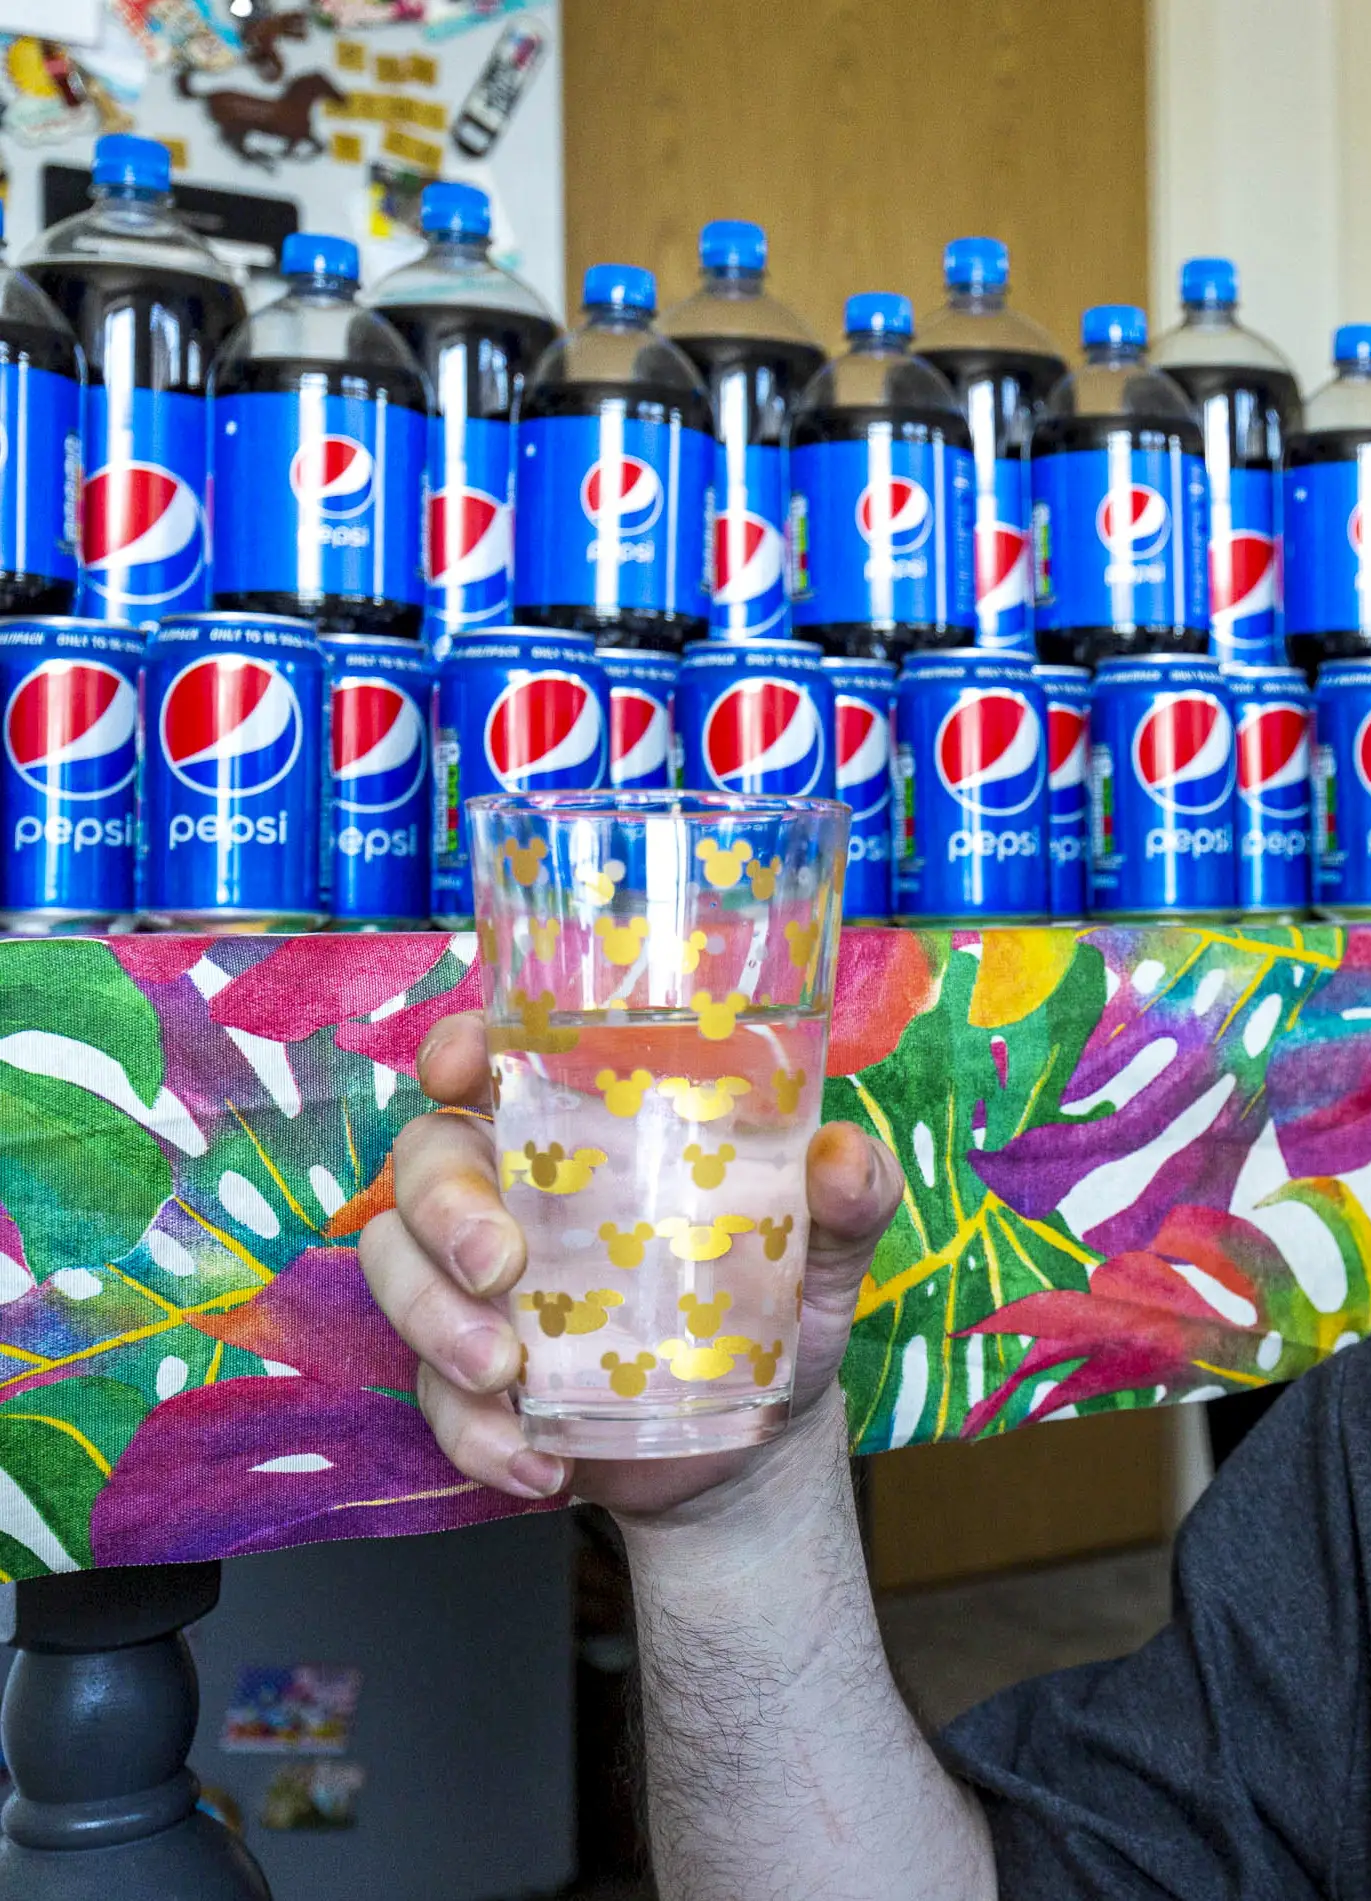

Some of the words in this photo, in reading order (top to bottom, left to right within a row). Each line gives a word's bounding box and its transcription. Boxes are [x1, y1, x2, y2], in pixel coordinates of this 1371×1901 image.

[14, 811, 133, 852] pepsi
[169, 809, 287, 850] pepsi
[330, 823, 418, 863] epsi
[948, 824, 1041, 863] pepsi
